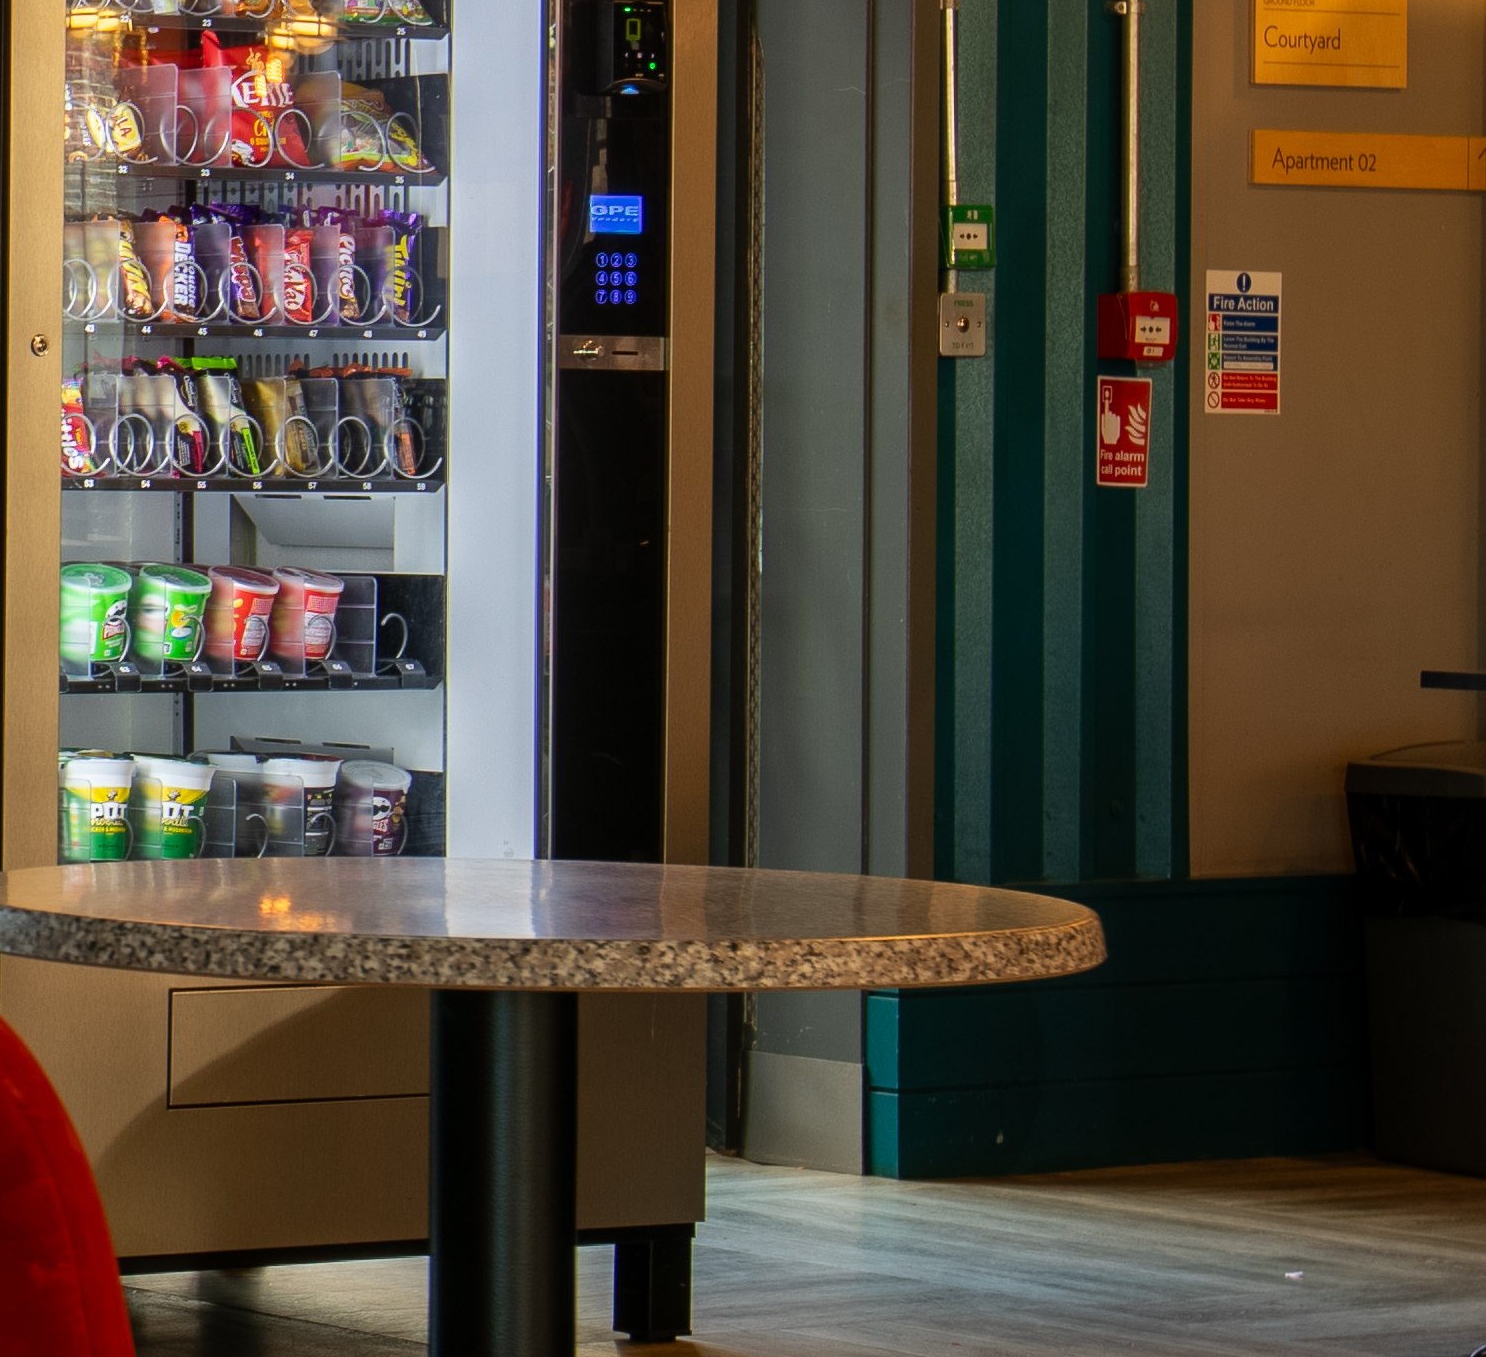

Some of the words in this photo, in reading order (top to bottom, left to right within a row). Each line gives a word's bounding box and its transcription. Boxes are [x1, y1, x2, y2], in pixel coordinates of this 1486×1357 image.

[1263, 25, 1342, 55] Courtyard
[1272, 147, 1354, 175] Apartment
[1357, 153, 1377, 172] 02
[591, 205, 639, 217] GPE
[174, 241, 192, 306] DECKER
[1213, 296, 1235, 310] Fire
[1237, 297, 1274, 311] Action
[1100, 449, 1113, 461] Fire
[1115, 450, 1144, 462] alarm
[1101, 464, 1112, 475] call
[1114, 465, 1142, 477] point
[91, 802, 128, 819] POT
[162, 802, 195, 819] OT
